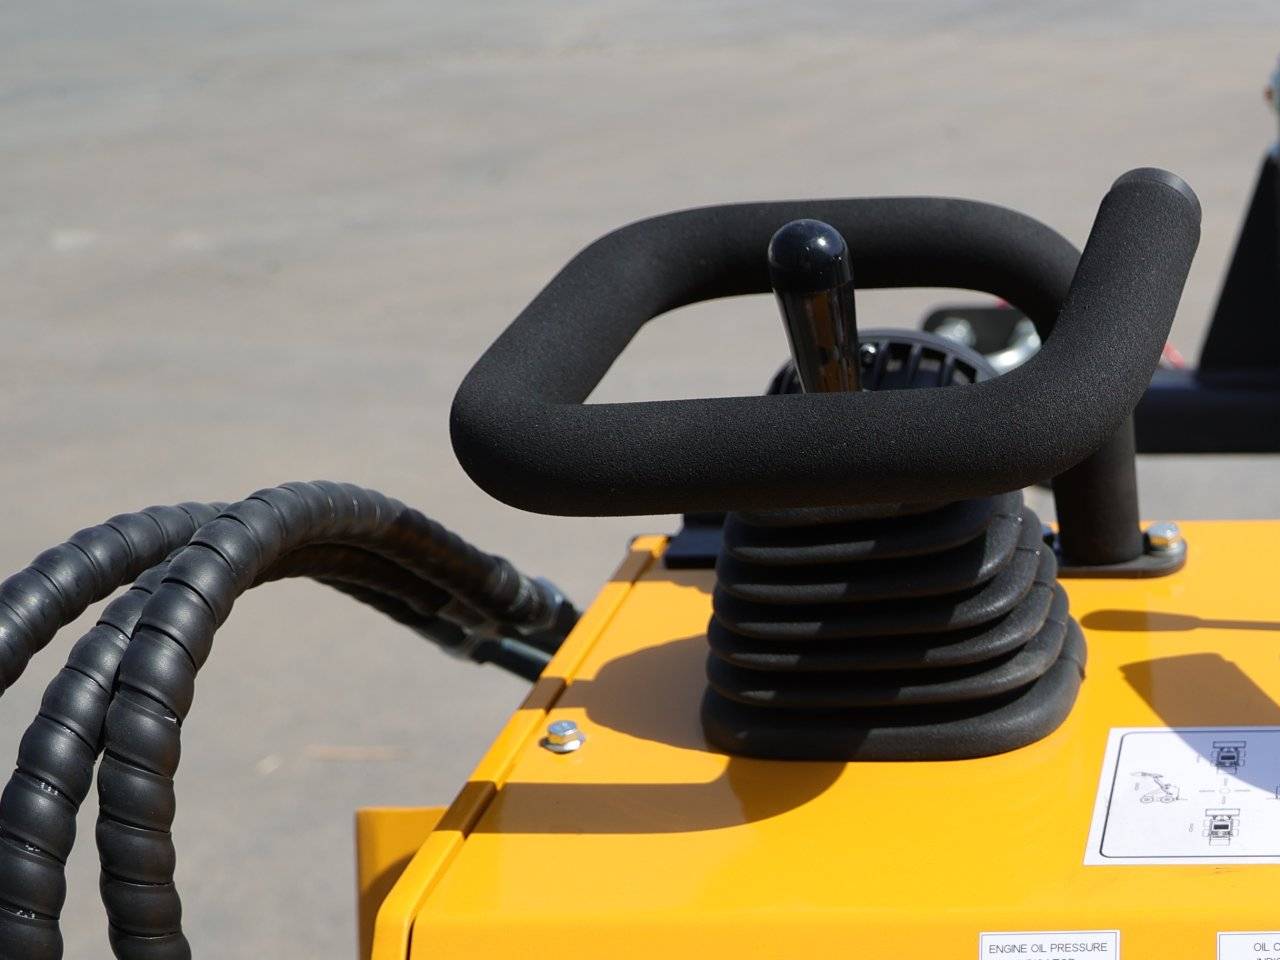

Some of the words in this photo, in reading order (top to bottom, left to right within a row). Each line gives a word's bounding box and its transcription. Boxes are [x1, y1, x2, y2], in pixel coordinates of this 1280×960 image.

[988, 943, 1028, 954] ENGINE
[1030, 942, 1048, 953] OIL
[1050, 942, 1109, 954] PRESSURE
[1252, 941, 1270, 952] OIL
